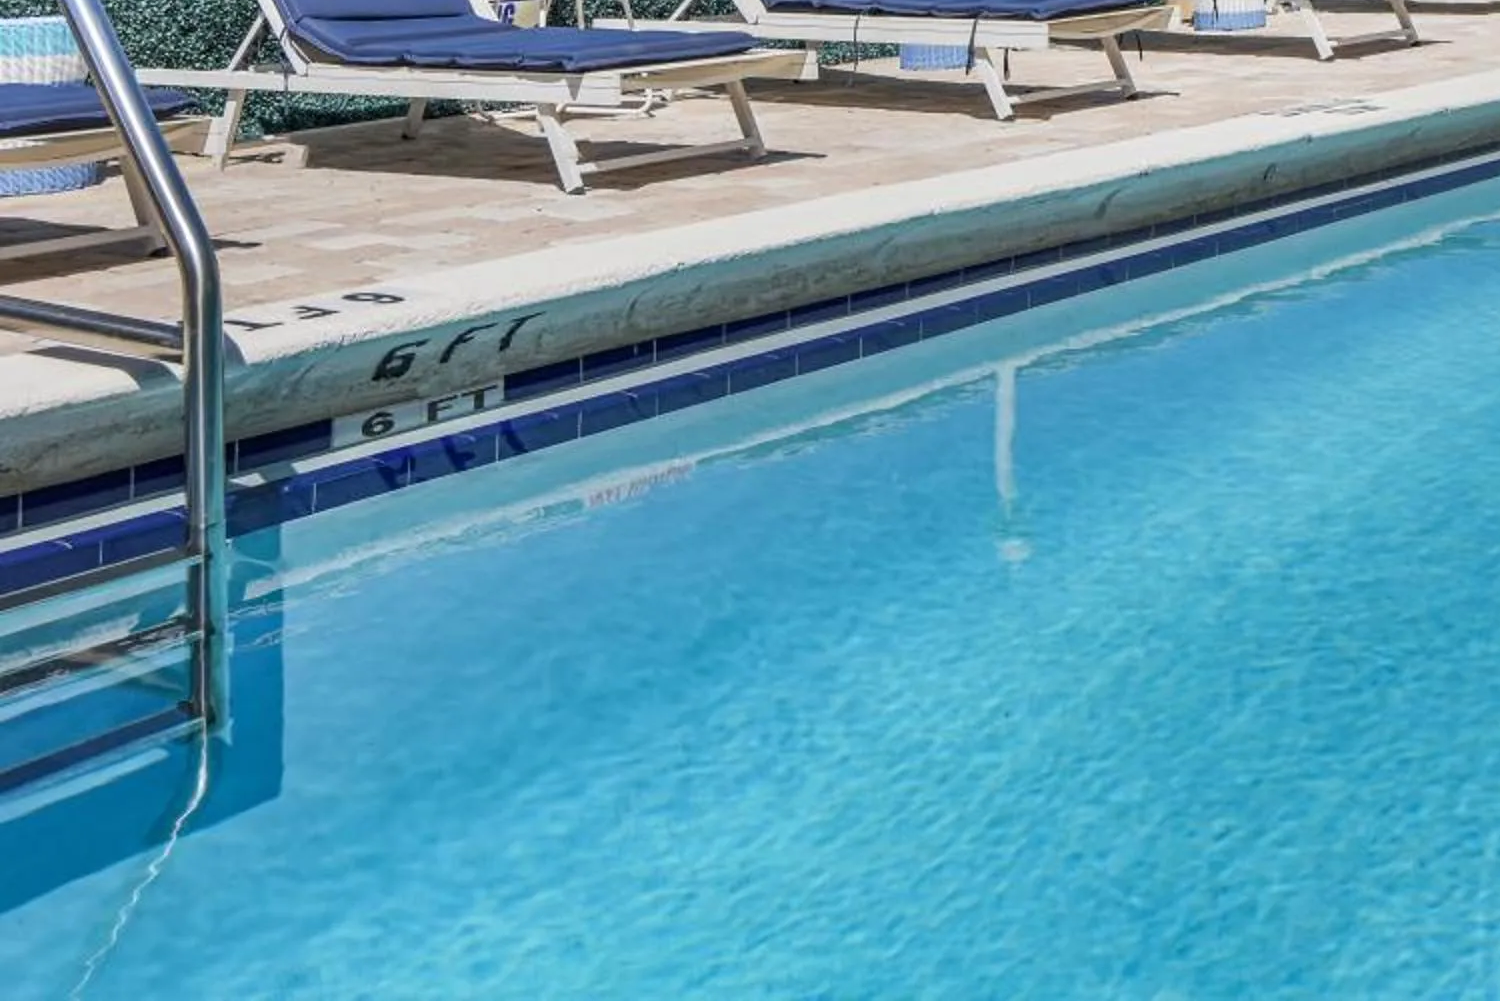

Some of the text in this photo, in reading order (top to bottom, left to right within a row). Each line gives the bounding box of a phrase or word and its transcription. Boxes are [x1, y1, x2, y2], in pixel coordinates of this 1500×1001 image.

[439, 310, 547, 364] FT
[361, 384, 498, 438] 6 FT
